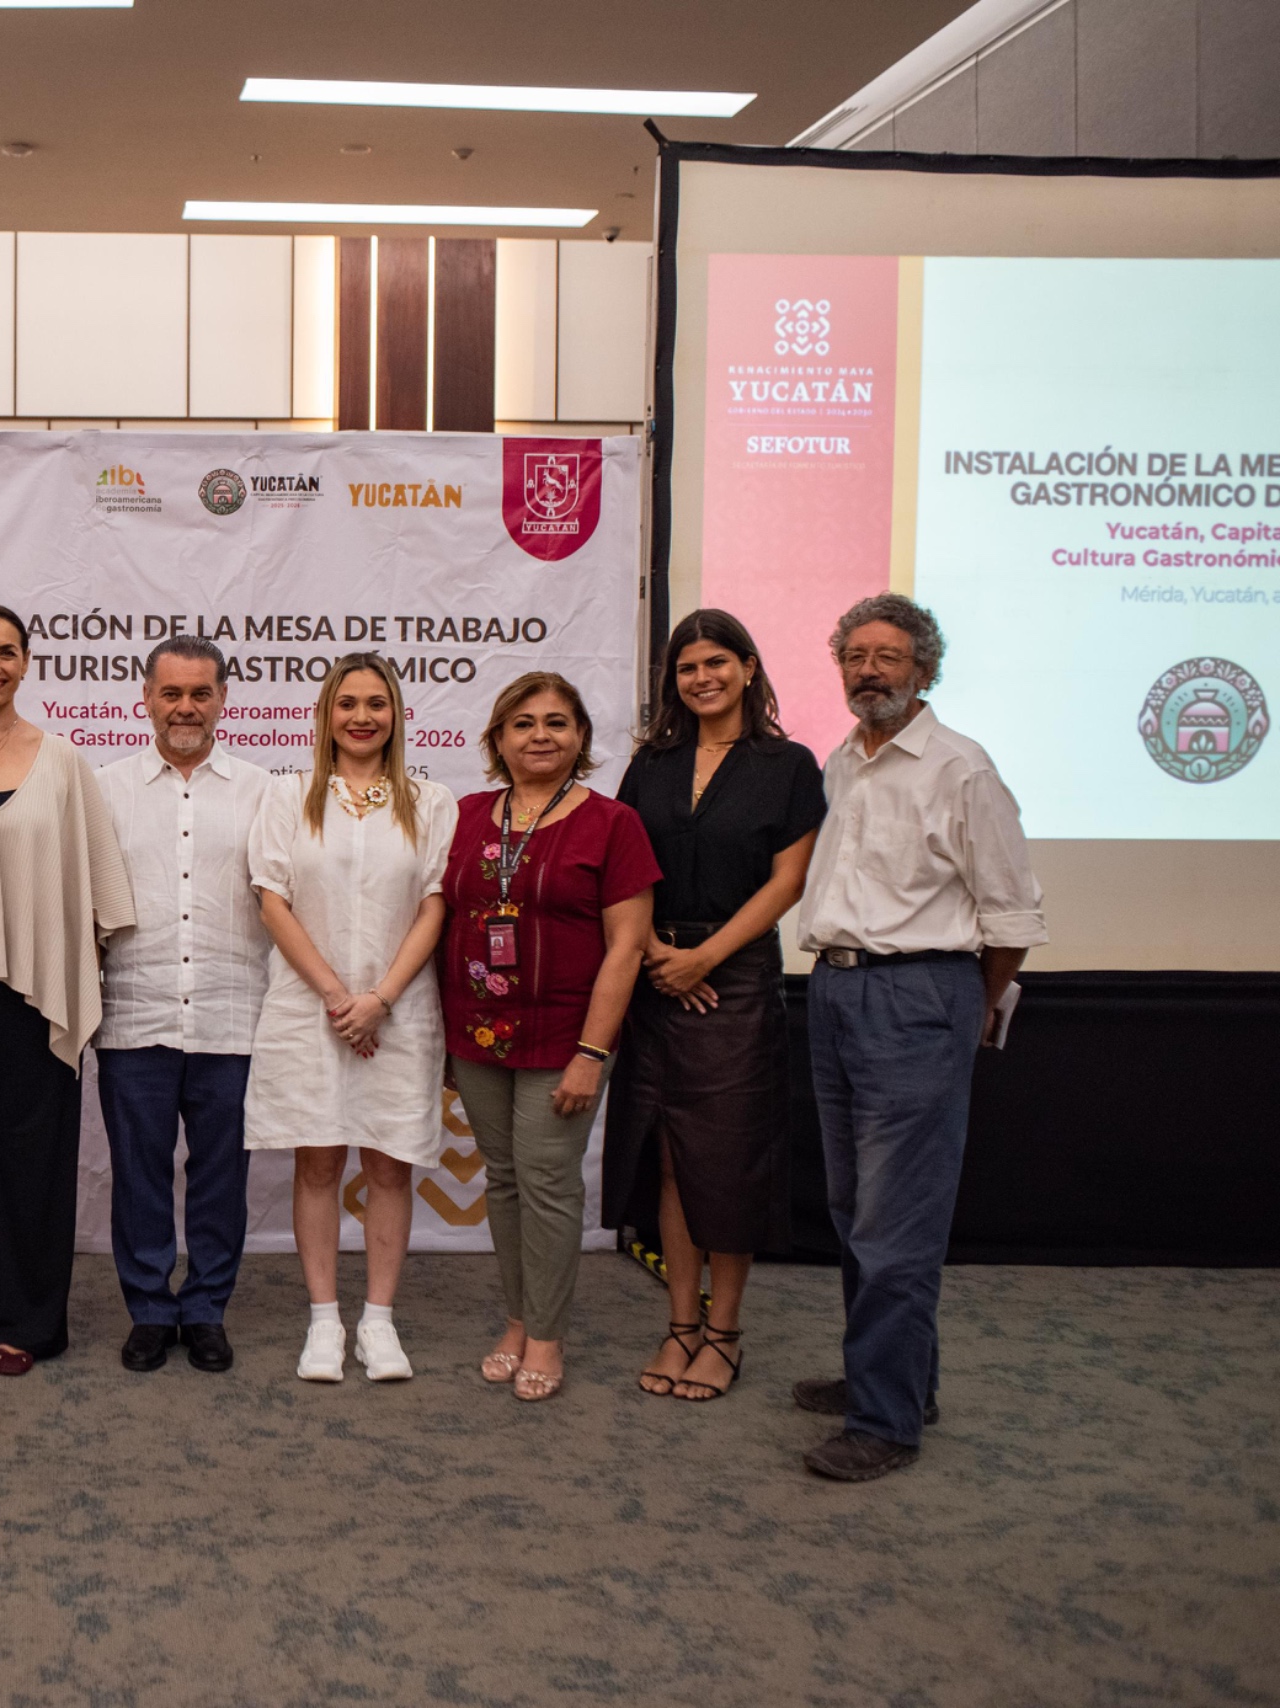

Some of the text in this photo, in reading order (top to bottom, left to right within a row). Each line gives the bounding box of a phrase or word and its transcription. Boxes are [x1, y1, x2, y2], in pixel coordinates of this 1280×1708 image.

[728, 366, 874, 376] RENACIMIENTO MAYA
[729, 378, 873, 403] YUCATÁN
[746, 435, 851, 455] SEFOTUR
[944, 445, 1280, 477] INSTALACIÓN DE LA ME
[250, 473, 320, 492] YUCATÁN
[1009, 476, 1256, 508] GASTRONÓMICO
[96, 495, 162, 504] iberoamericana
[348, 478, 462, 509] YUCATÁN
[106, 504, 162, 513] gastronomía
[1105, 522, 1205, 543] Yucatán,
[1051, 548, 1136, 567] Cultura
[1120, 586, 1188, 606] Mérida,
[1190, 586, 1270, 606] Yucatán,
[143, 614, 187, 641] DE
[197, 614, 237, 642] LA
[245, 615, 337, 642] MESA
[345, 616, 387, 642] DE
[394, 616, 547, 643] TRABAJO
[42, 701, 128, 721] Yucatán,
[70, 728, 466, 748] Gastron Precolomb -2026
